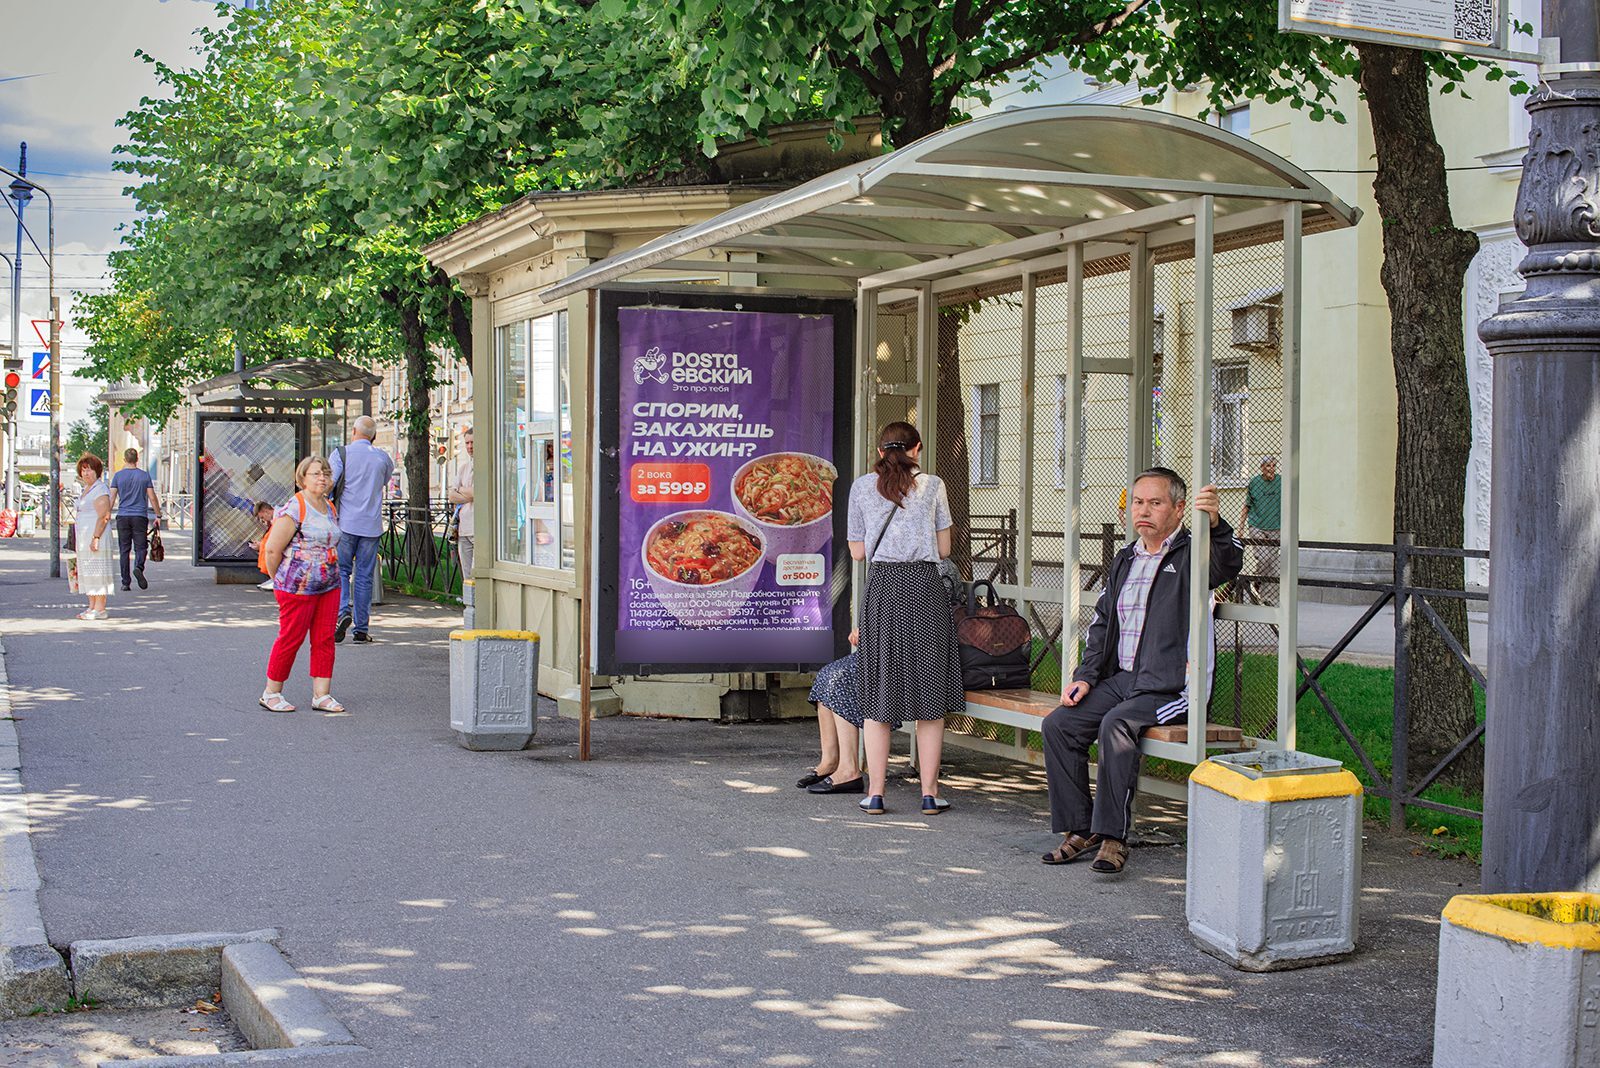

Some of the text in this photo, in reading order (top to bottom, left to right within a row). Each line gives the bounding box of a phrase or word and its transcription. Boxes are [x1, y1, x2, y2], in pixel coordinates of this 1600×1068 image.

[672, 384, 729, 393] Это про тебя
[632, 402, 744, 421] СПОРИМ,
[632, 421, 775, 438] ЗАКАЖЕШЬ
[632, 441, 757, 457] НА УЖИН?
[637, 469, 672, 479] 2 вока
[637, 484, 657, 495] за
[630, 578, 651, 590] 16+
[641, 592, 673, 600] разных
[731, 590, 785, 599] Подробности
[796, 589, 821, 597] сайте
[629, 600, 688, 609] dostaevsky.ru
[689, 599, 710, 608] ООО
[781, 598, 805, 606] ОГРН
[763, 607, 790, 616] Санкт-
[679, 617, 748, 627] Кондратьевский
[771, 616, 780, 624] 15
[803, 615, 810, 624] 5
